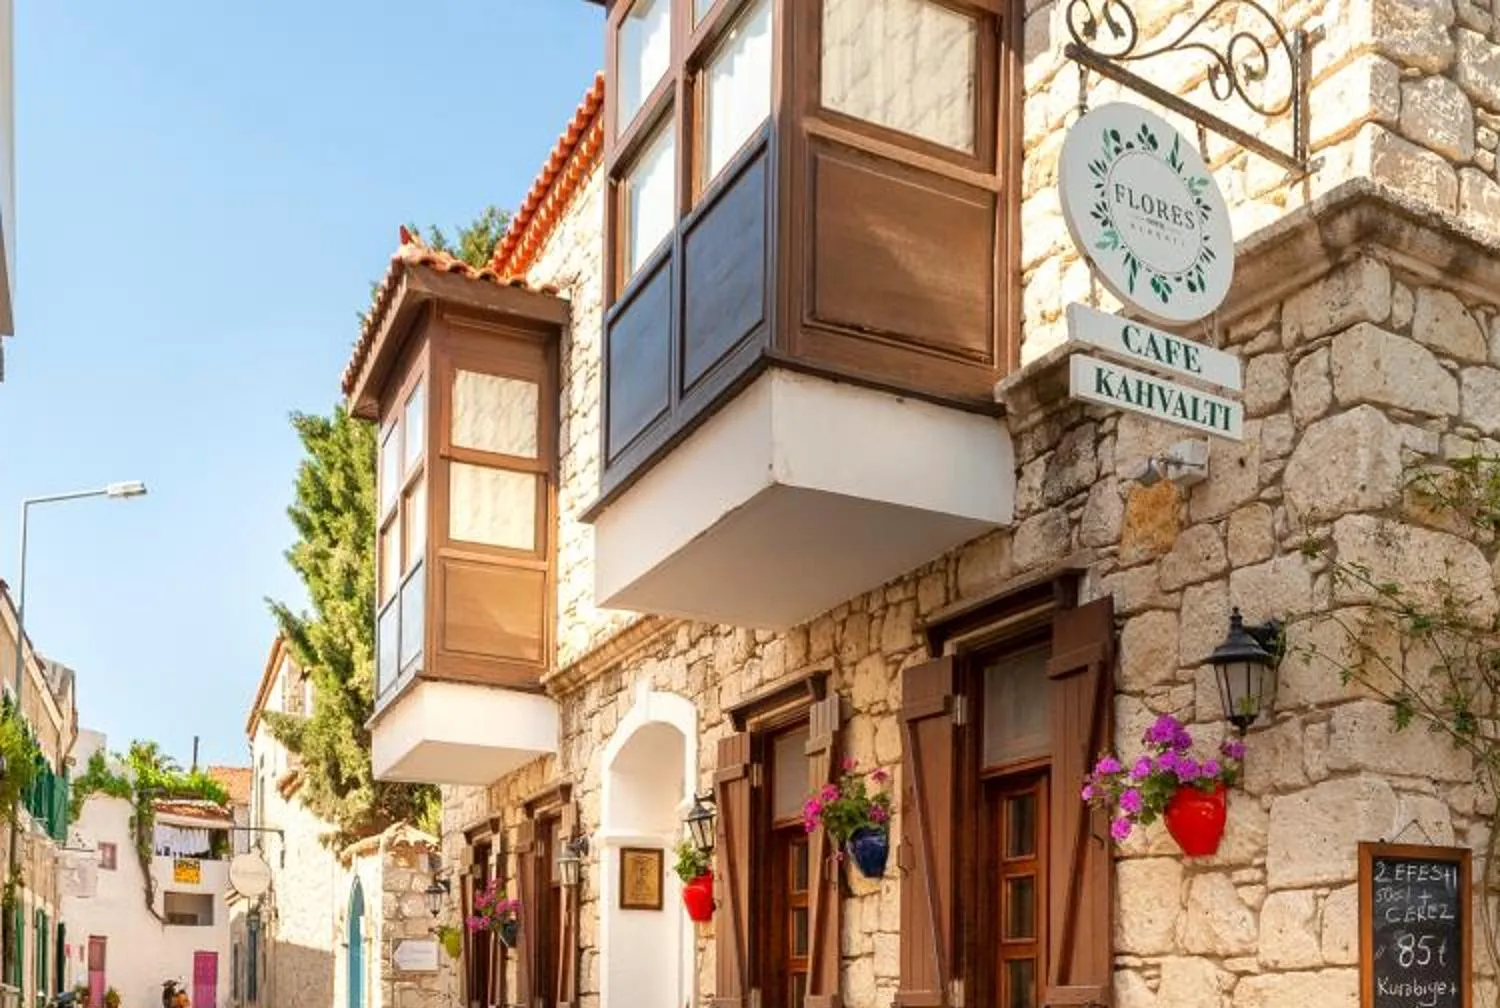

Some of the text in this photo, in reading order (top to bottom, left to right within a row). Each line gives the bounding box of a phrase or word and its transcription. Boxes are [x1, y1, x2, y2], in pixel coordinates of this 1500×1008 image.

[1114, 183, 1195, 230] FLORES
[1121, 324, 1202, 375] CAFE
[1095, 367, 1232, 431] KAHVALTI
[1374, 861, 1392, 883] 2
